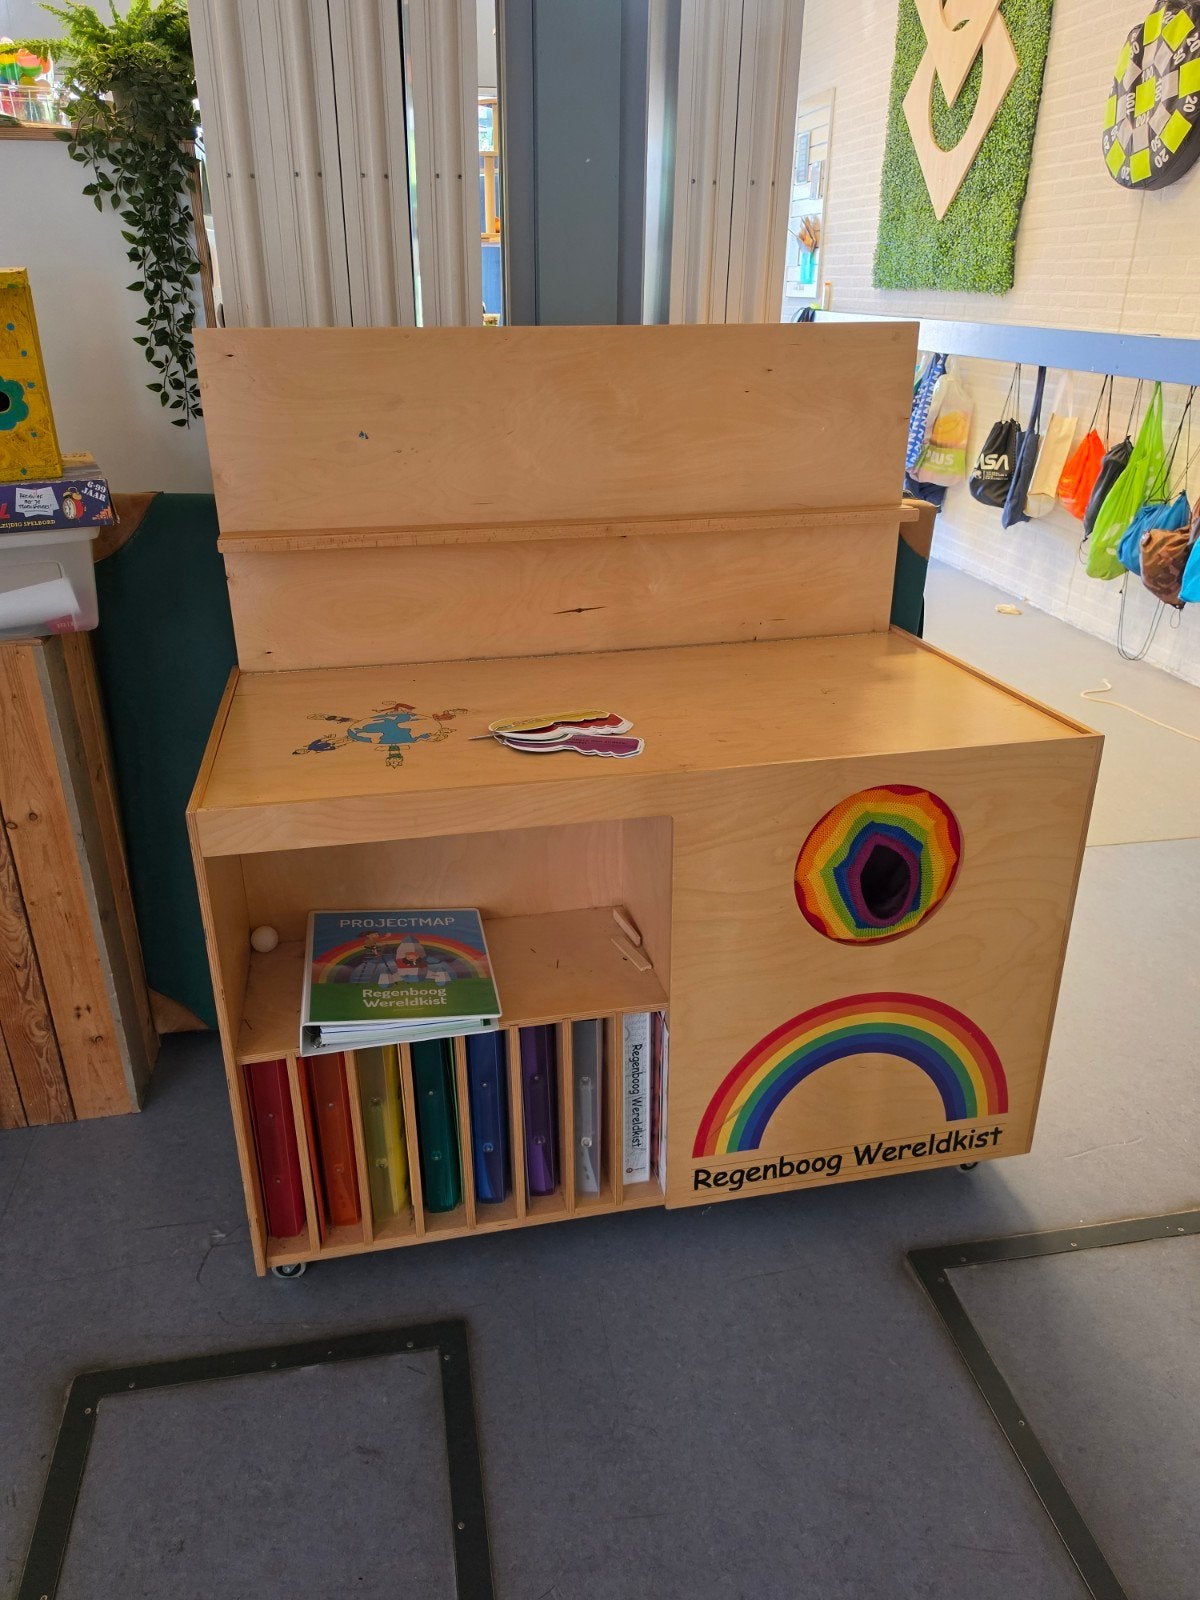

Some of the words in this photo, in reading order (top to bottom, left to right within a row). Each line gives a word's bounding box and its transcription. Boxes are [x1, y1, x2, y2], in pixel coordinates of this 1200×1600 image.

[1126, 92, 1136, 115] 100
[1183, 95, 1198, 113] 20
[1150, 135, 1162, 152] 50
[1154, 148, 1169, 168] 20
[81, 487, 106, 503] JAAR
[87, 481, 106, 494] 6-99
[23, 519, 56, 527] SPELBORD
[339, 916, 456, 929] PROJECTMAP
[362, 987, 447, 1002] Regenboog
[363, 997, 448, 1009] Wereldkist
[628, 1043, 643, 1095] Regenboog
[631, 1096, 643, 1148] Wereldkist
[693, 1154, 842, 1192] Regenboog
[853, 1126, 1004, 1166] Wereldkist
